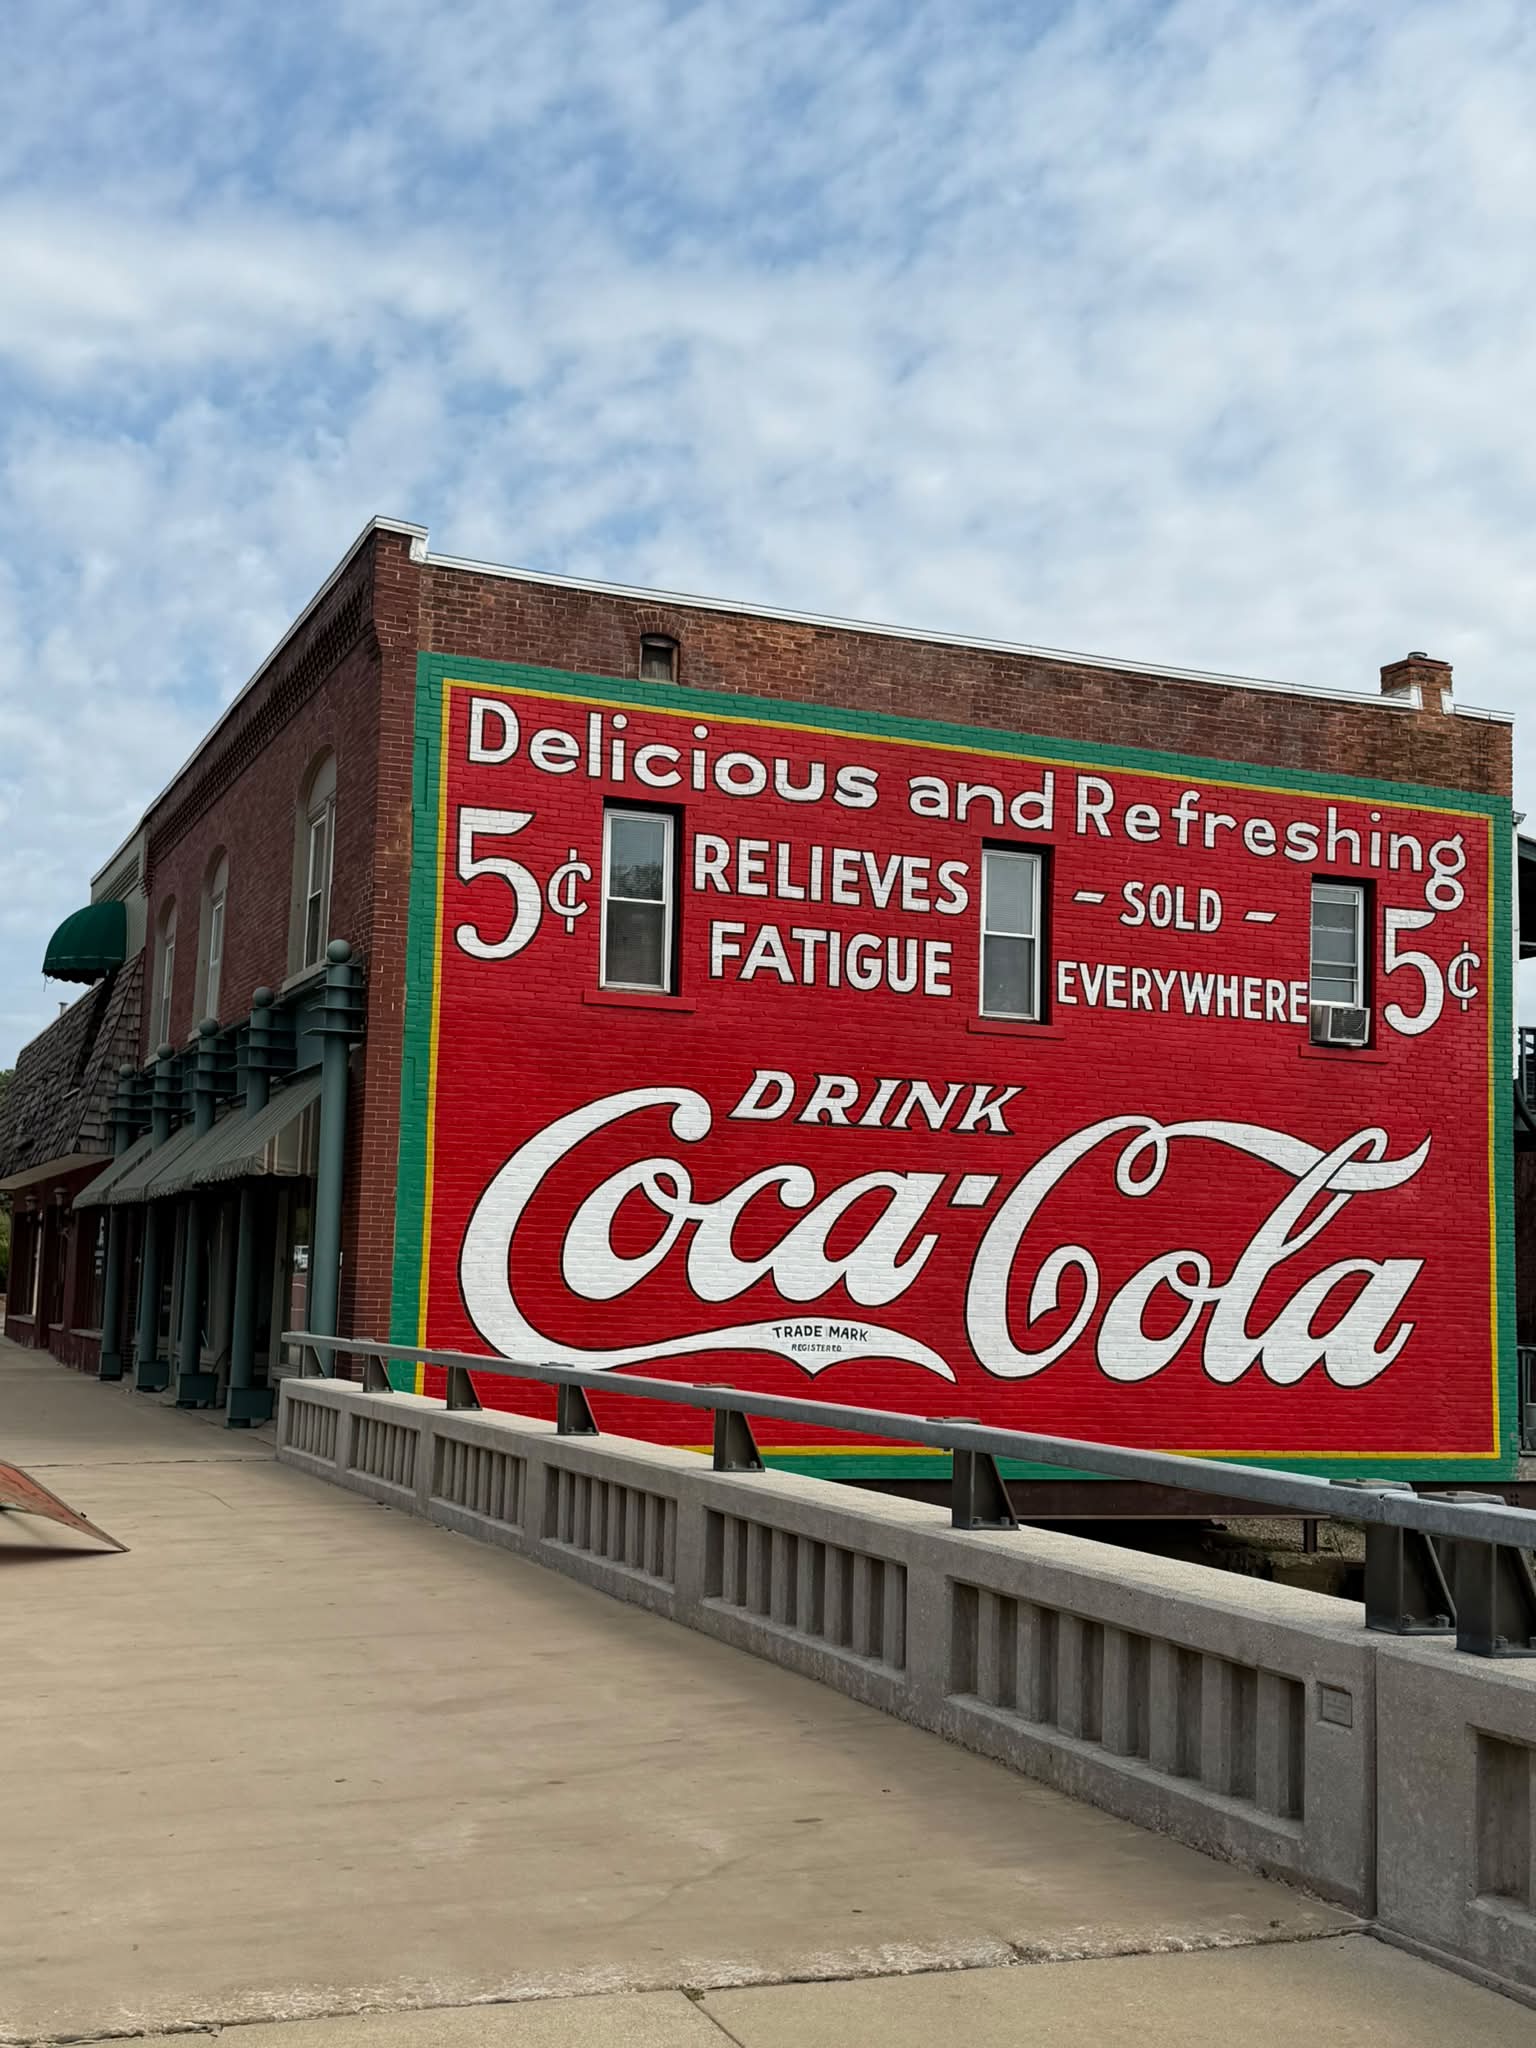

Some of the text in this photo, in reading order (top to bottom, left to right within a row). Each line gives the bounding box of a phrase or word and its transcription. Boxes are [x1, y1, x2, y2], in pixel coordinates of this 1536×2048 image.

[467, 696, 1468, 911] Delicious and Refreshing
[454, 804, 593, 961] 5¢
[693, 833, 970, 916] RELIEVES
[1119, 880, 1223, 933] SOLD
[709, 920, 953, 997] FATIGUE
[1057, 960, 1308, 1025] EVERYWHERE
[1383, 908, 1482, 1036] 5¢
[727, 1069, 1026, 1135] DRINK
[457, 1086, 1432, 1389] Coca-Cola
[772, 1325, 869, 1342] TRADE MARK
[791, 1343, 842, 1352] REGISTERED
